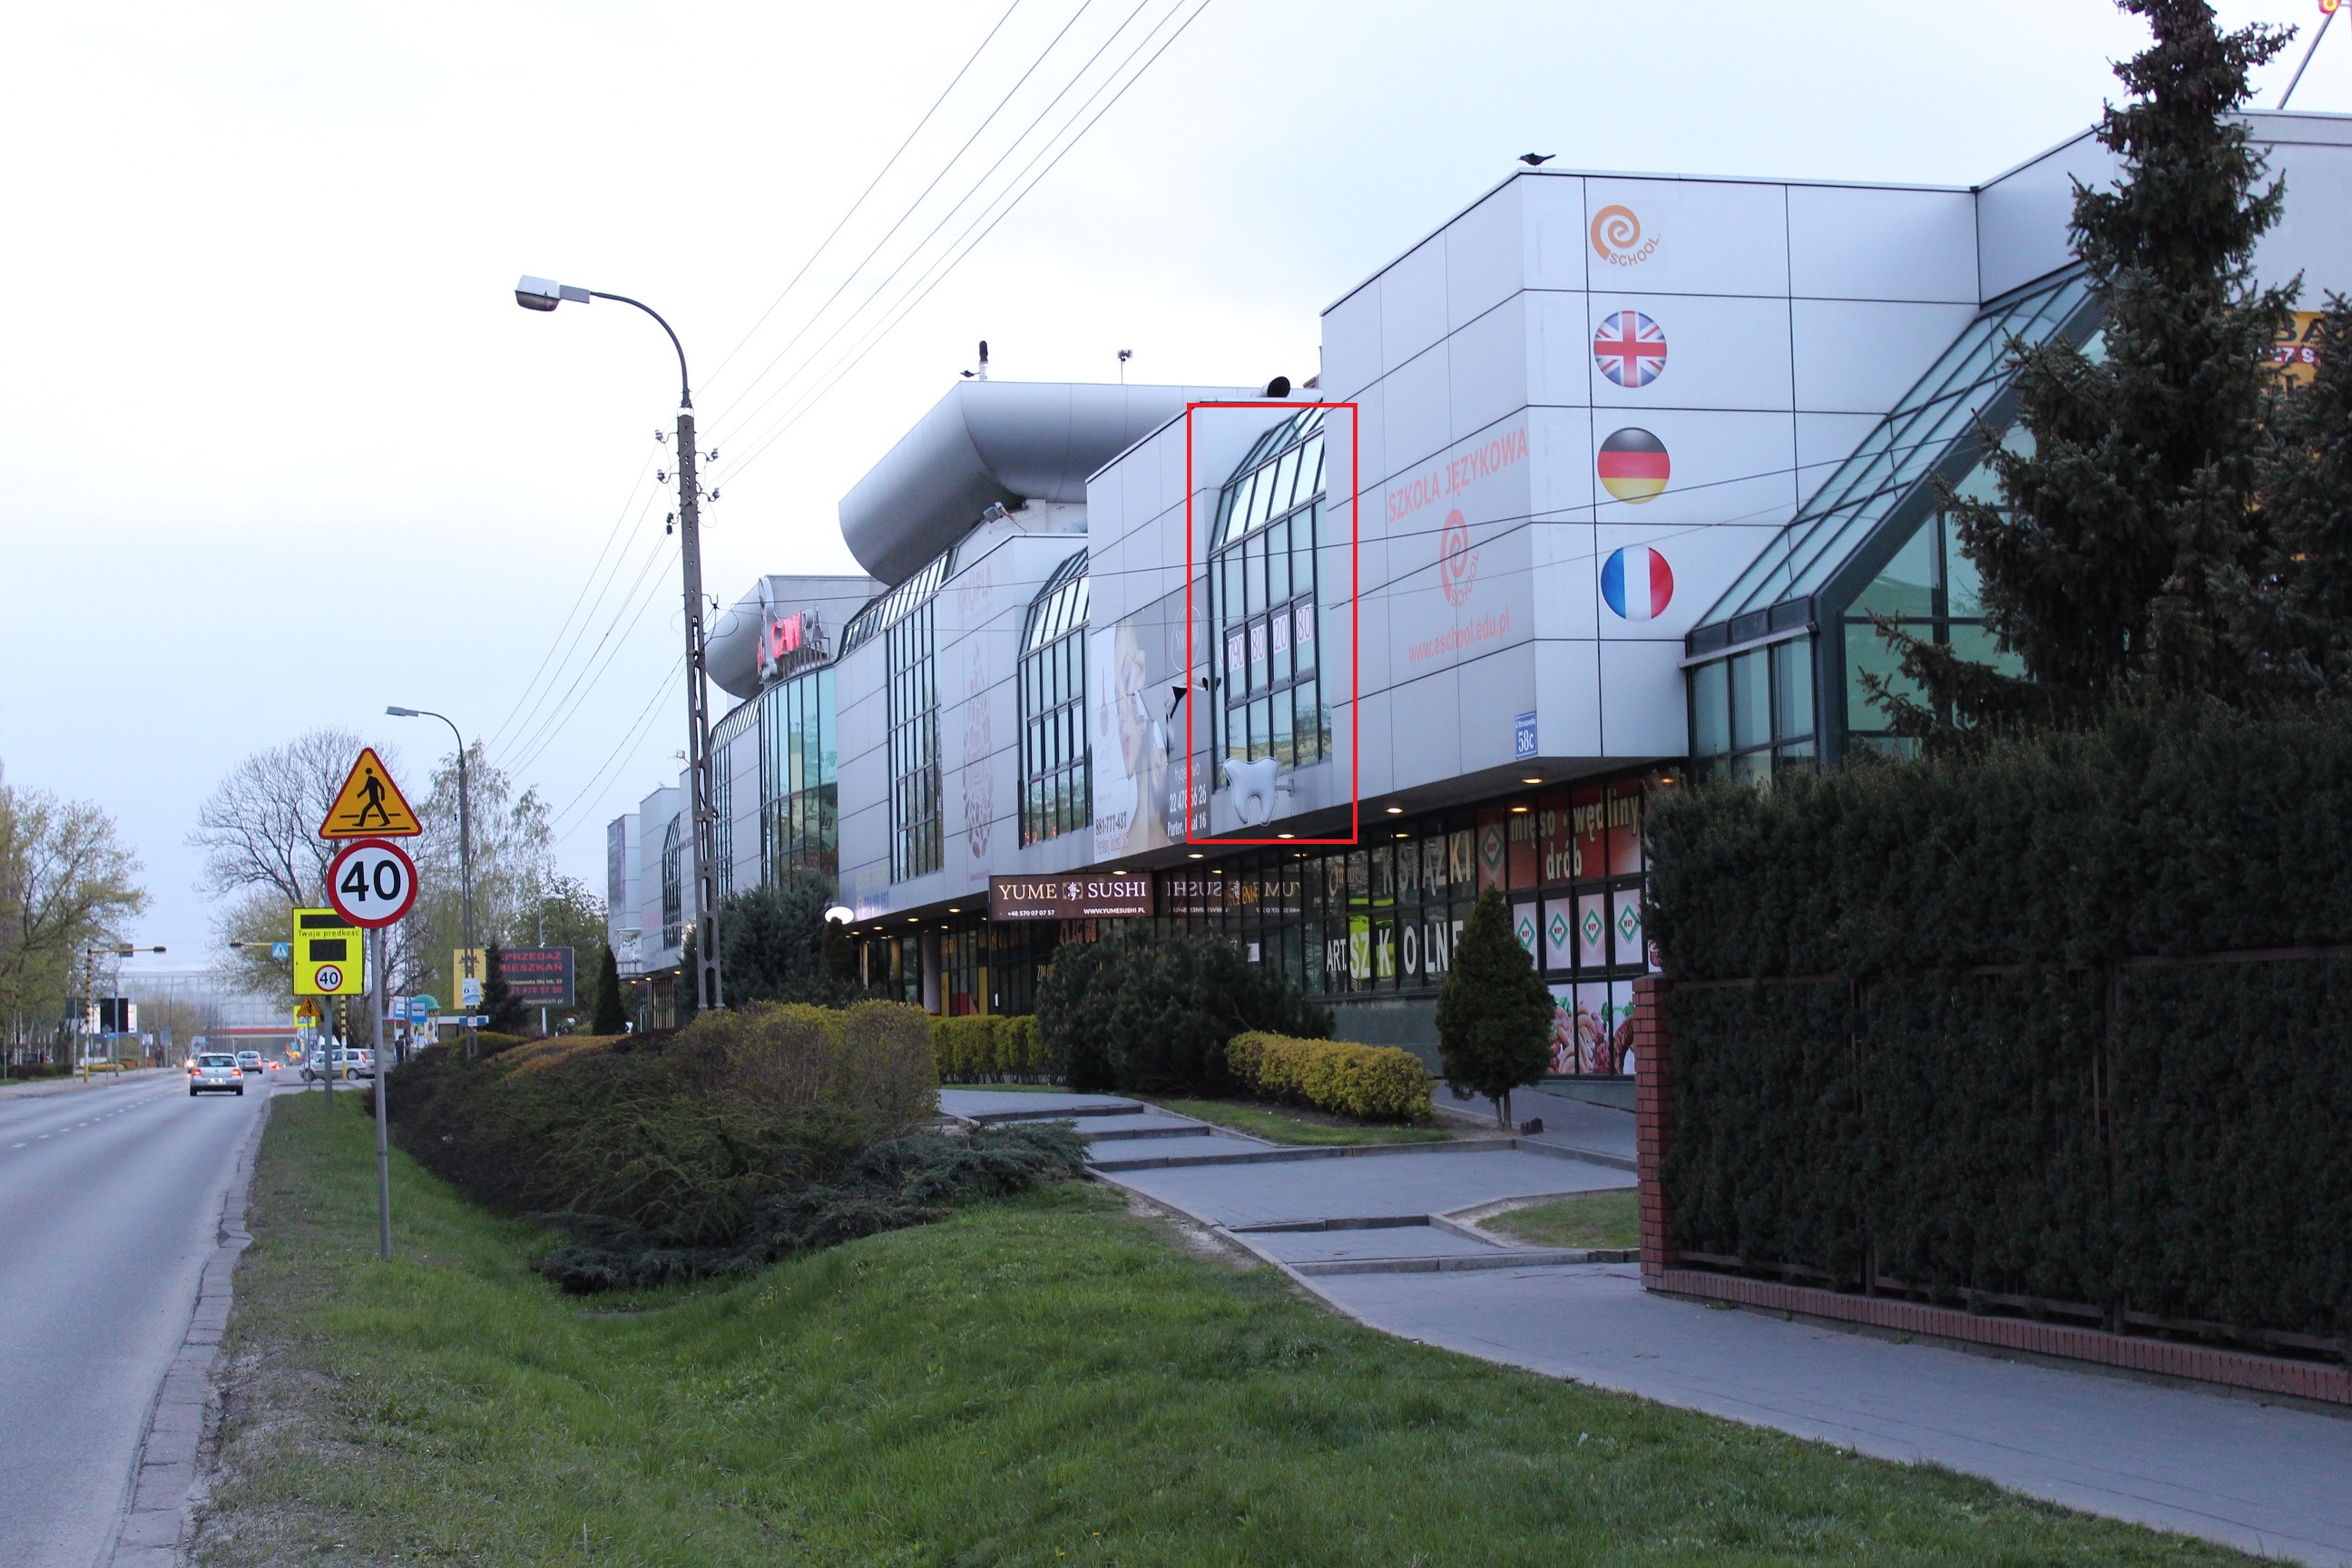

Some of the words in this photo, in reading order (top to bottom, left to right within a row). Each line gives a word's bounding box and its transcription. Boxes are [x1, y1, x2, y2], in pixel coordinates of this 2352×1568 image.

[1388, 471, 1440, 524] SZKOŁA
[1445, 427, 1529, 496] JĘZYKOWA
[1251, 628, 1264, 661] 80
[1274, 616, 1287, 651] 20
[1298, 606, 1311, 641] 80
[1408, 606, 1510, 664] www.eschool.edu.pl
[1518, 730, 1534, 752] 58c
[1573, 787, 1640, 843] wędliny
[1546, 838, 1583, 880] drób
[340, 859, 401, 902] 40
[999, 883, 1057, 900] YUME
[1088, 881, 1146, 898] SUSHI
[323, 929, 359, 937] prędkość
[1031, 909, 1038, 917] 07
[319, 972, 338, 985] 40
